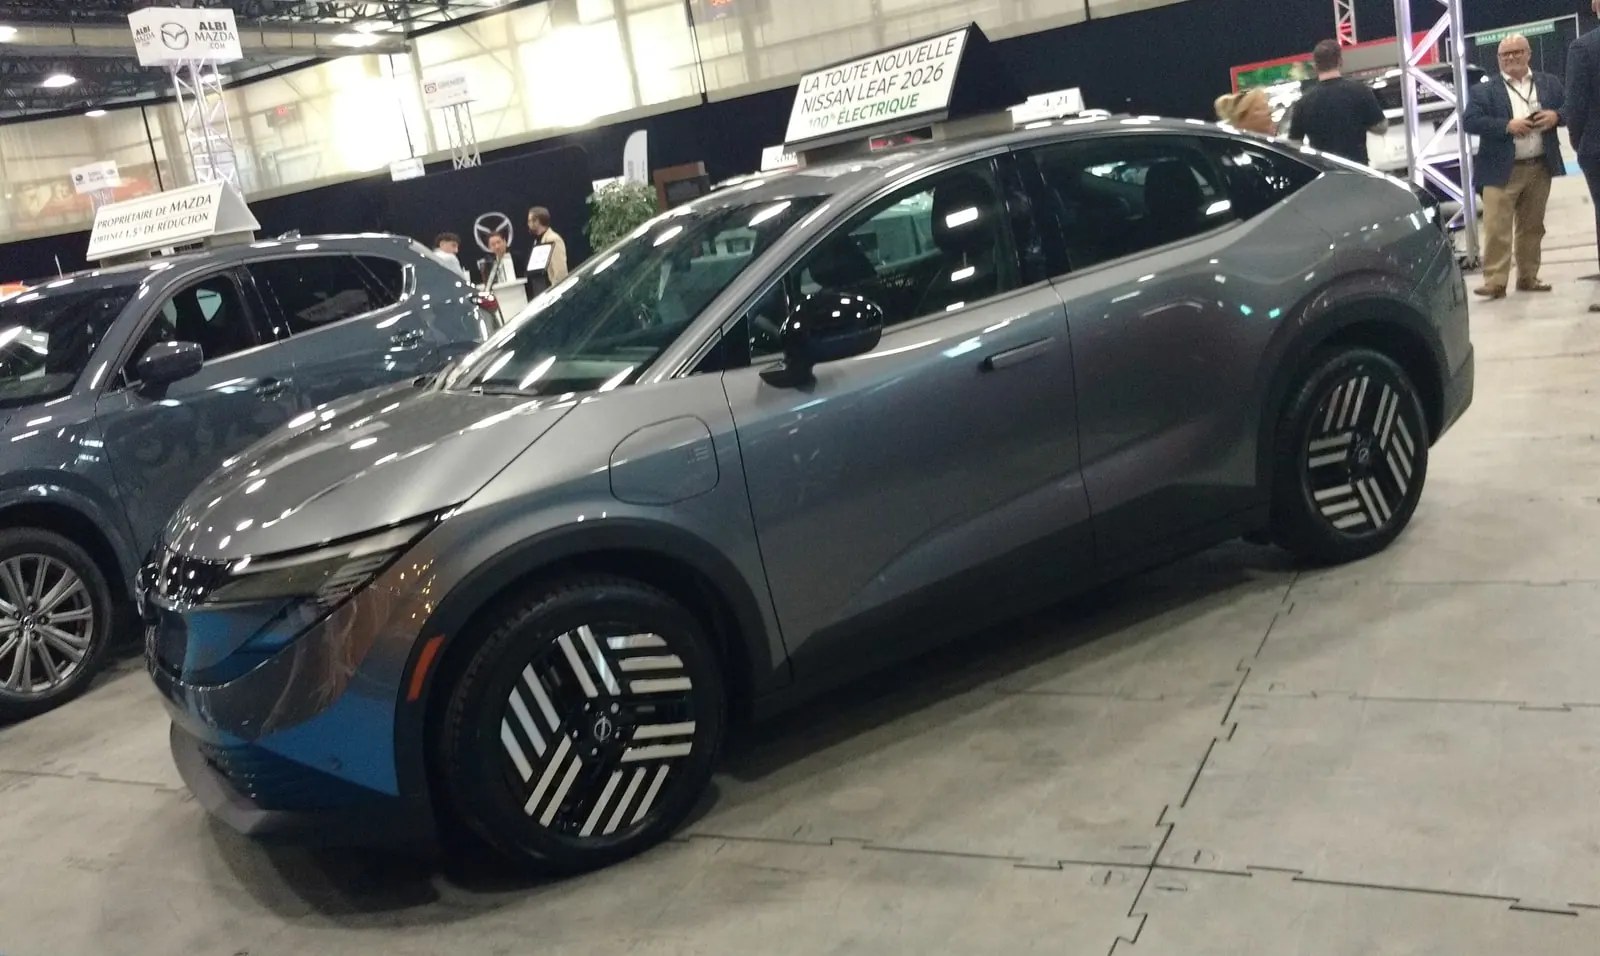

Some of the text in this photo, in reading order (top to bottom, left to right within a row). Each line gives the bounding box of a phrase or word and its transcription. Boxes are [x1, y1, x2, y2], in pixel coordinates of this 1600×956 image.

[194, 31, 235, 42] MAZDA
[199, 21, 227, 31] ALBI
[803, 36, 957, 94] LA TOUTE NOUVELLE
[801, 61, 945, 115] NISSAN LEAF 2026
[837, 92, 920, 125] ÉLECTRIQUE
[96, 193, 212, 230] PROPRIÉTAIRE DE MAZDA
[143, 223, 155, 235] DE
[157, 211, 209, 232] RÉDUCTION
